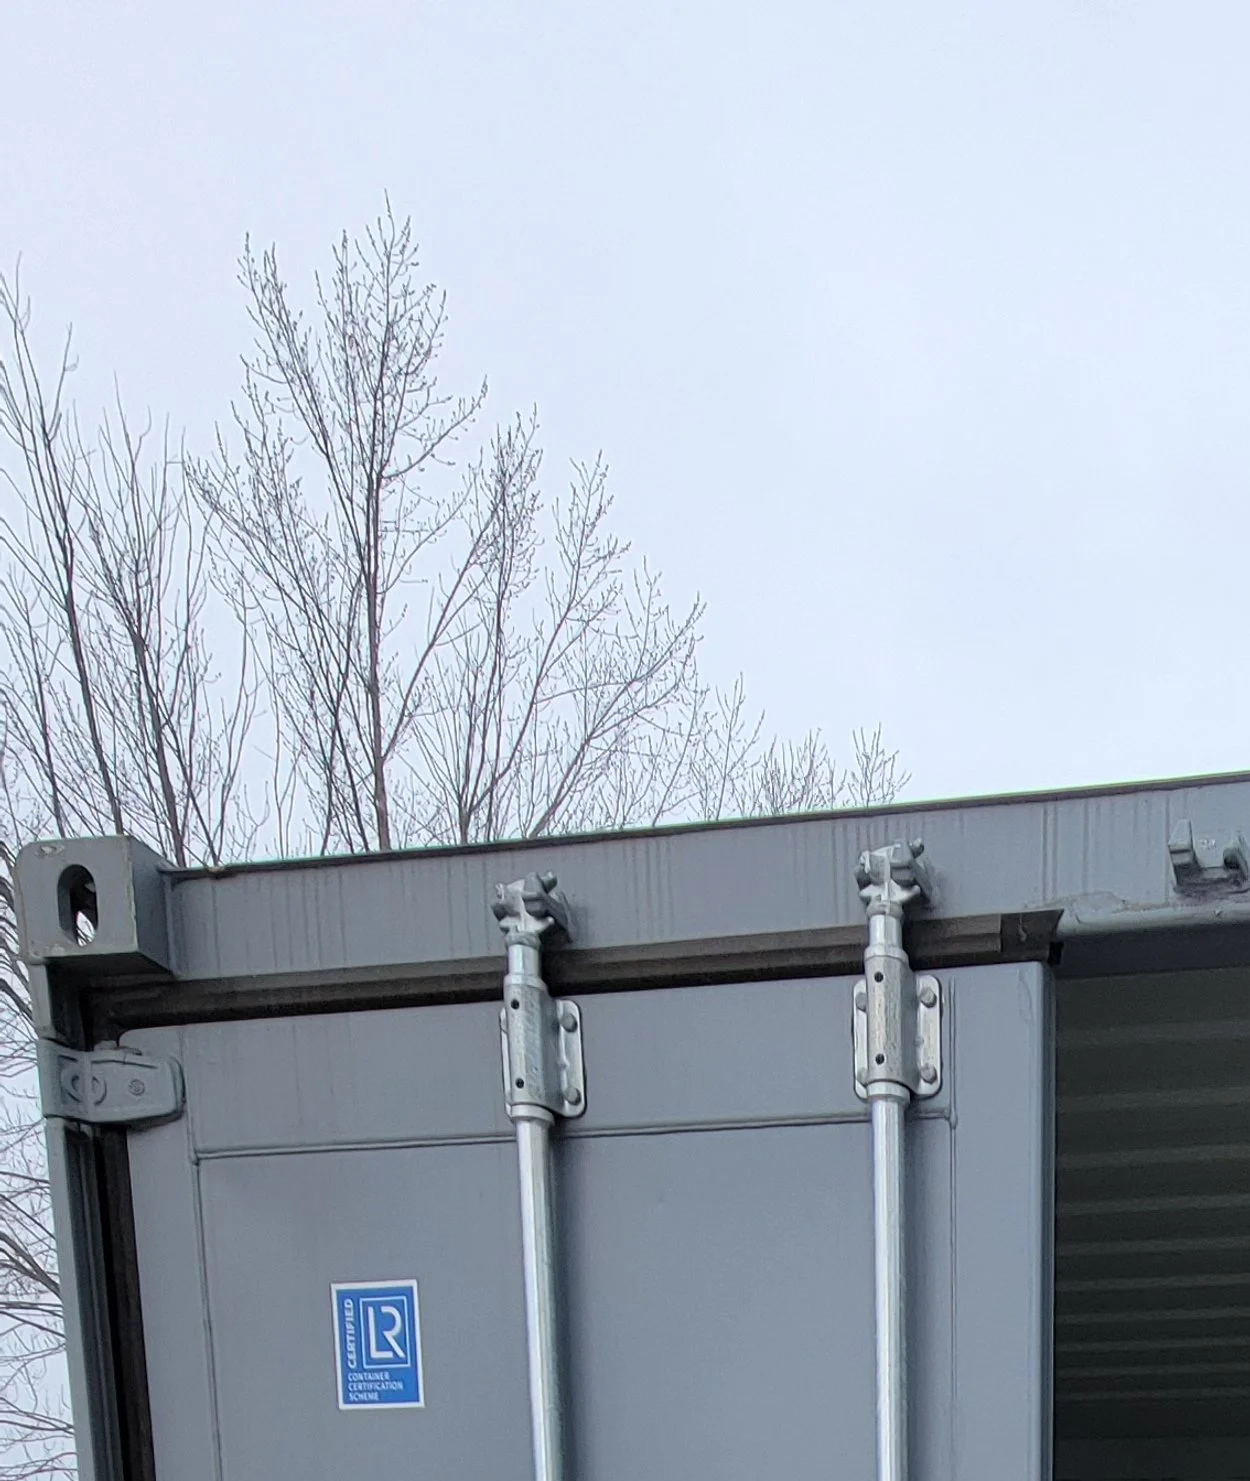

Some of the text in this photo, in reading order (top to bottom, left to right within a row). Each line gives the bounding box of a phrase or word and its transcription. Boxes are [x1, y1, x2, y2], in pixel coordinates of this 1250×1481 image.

[344, 1298, 357, 1369] CERTIFIED
[367, 1306, 406, 1358] LR
[348, 1371, 390, 1382] CONTAINER
[348, 1381, 404, 1392] CERTIFICATION
[348, 1391, 379, 1401] SCHEME
